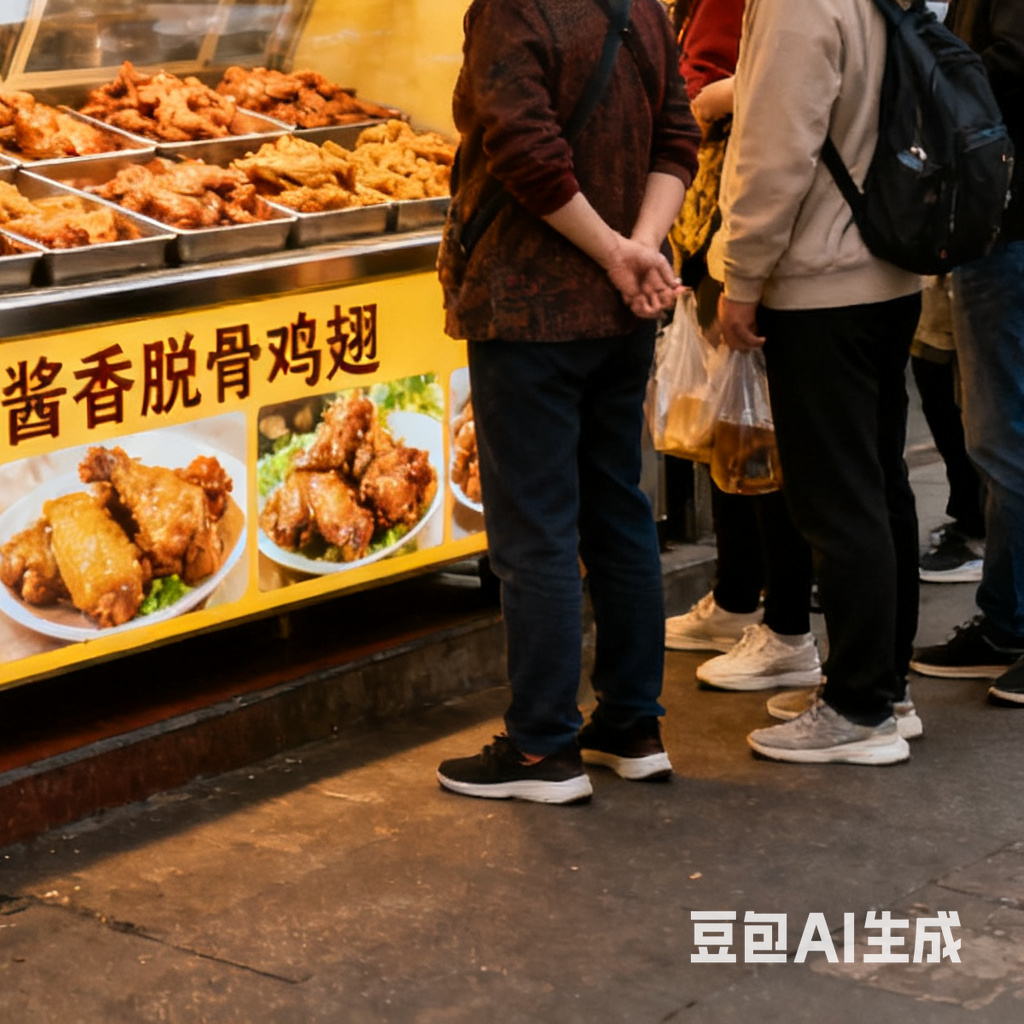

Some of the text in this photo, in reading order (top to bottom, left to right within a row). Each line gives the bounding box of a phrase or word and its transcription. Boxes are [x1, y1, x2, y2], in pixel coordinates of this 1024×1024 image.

[1, 304, 381, 446] 酱香脱骨鸡翅
